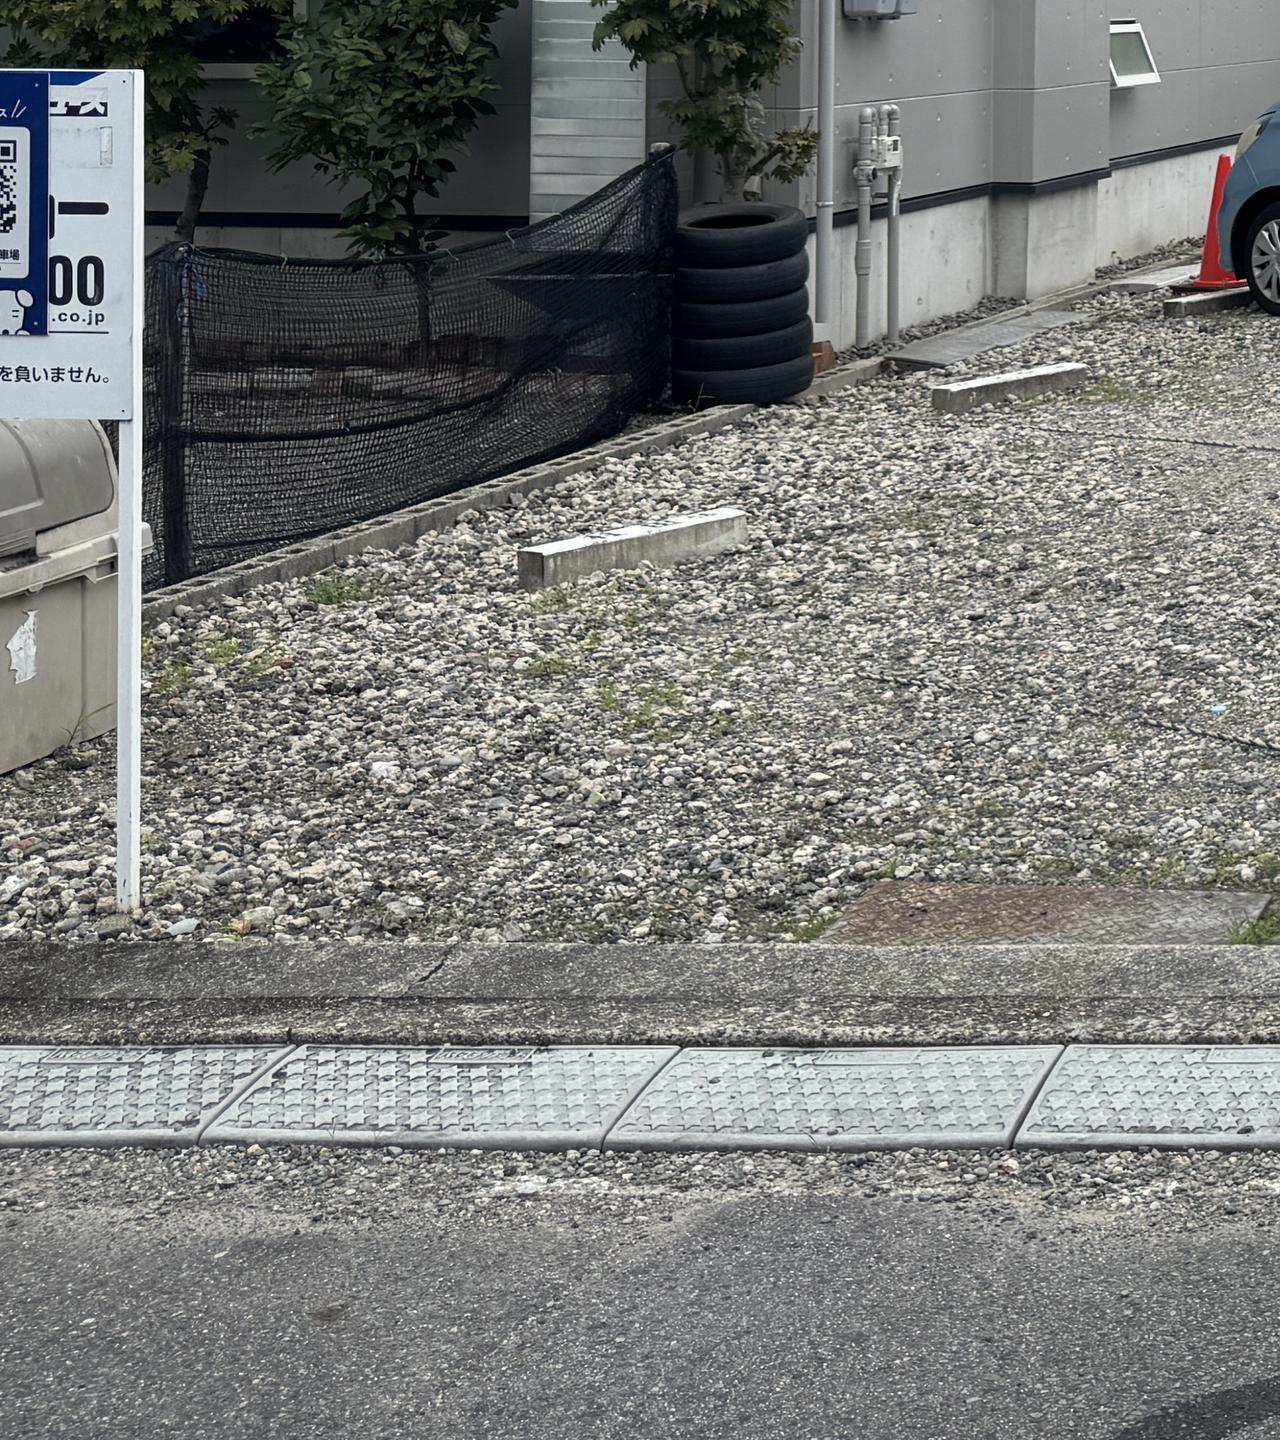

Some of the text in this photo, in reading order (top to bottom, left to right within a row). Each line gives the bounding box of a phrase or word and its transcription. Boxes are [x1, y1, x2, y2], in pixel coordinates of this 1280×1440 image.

[0, 365, 110, 384] を負いません。
